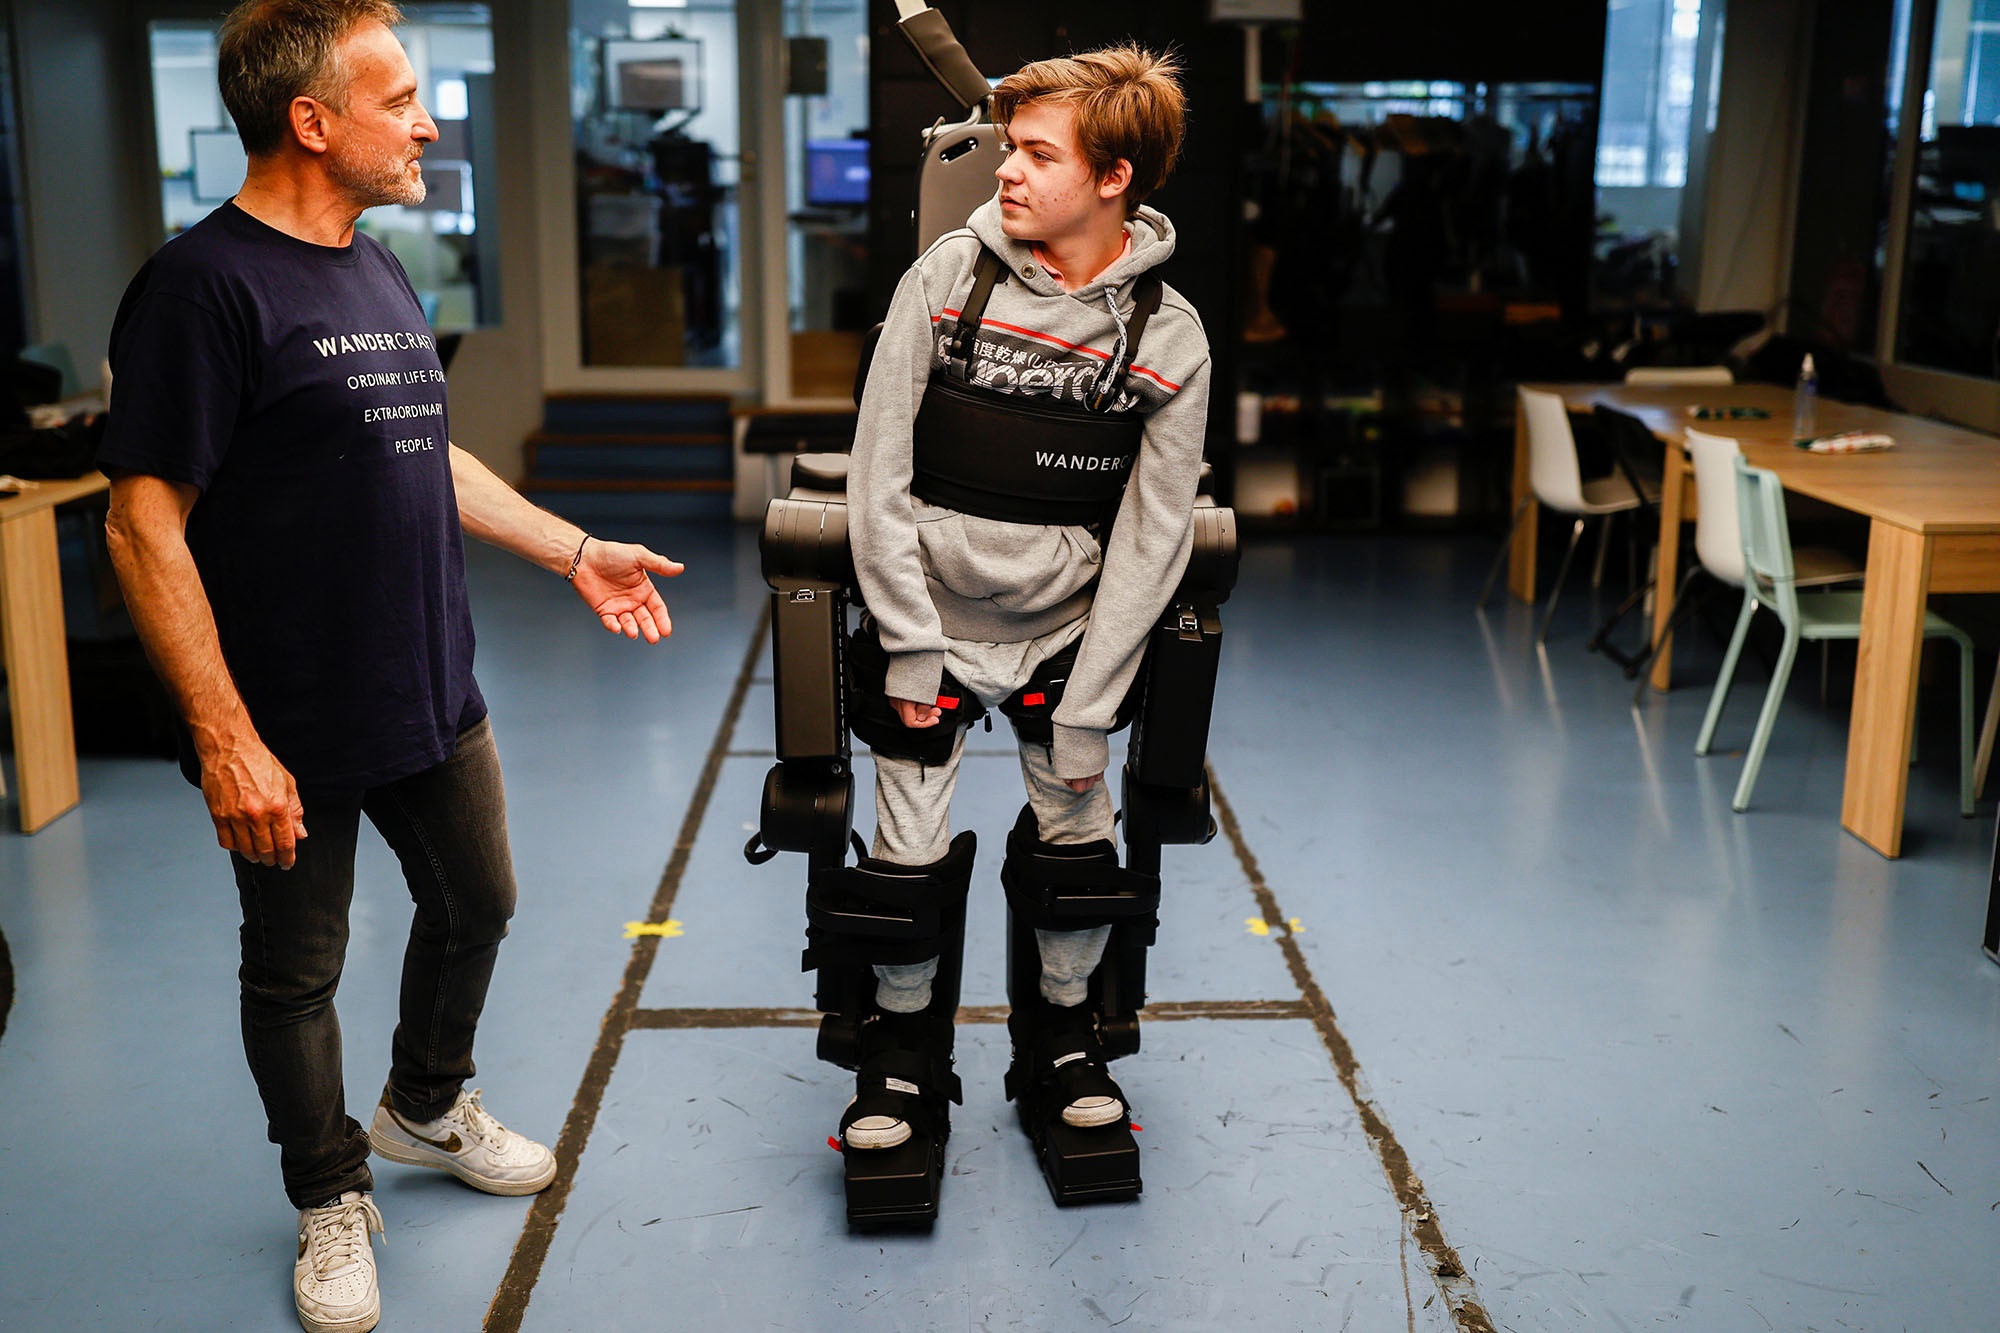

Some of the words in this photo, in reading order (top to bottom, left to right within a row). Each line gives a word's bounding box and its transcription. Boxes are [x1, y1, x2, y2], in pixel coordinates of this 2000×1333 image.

[313, 332, 436, 358] WANDERCRAFT
[347, 372, 401, 390] ORDINARY
[404, 370, 427, 385] LIFE
[429, 369, 446, 383] FOR
[395, 437, 434, 454] PEOPLE
[1035, 451, 1129, 471] WANDERC
